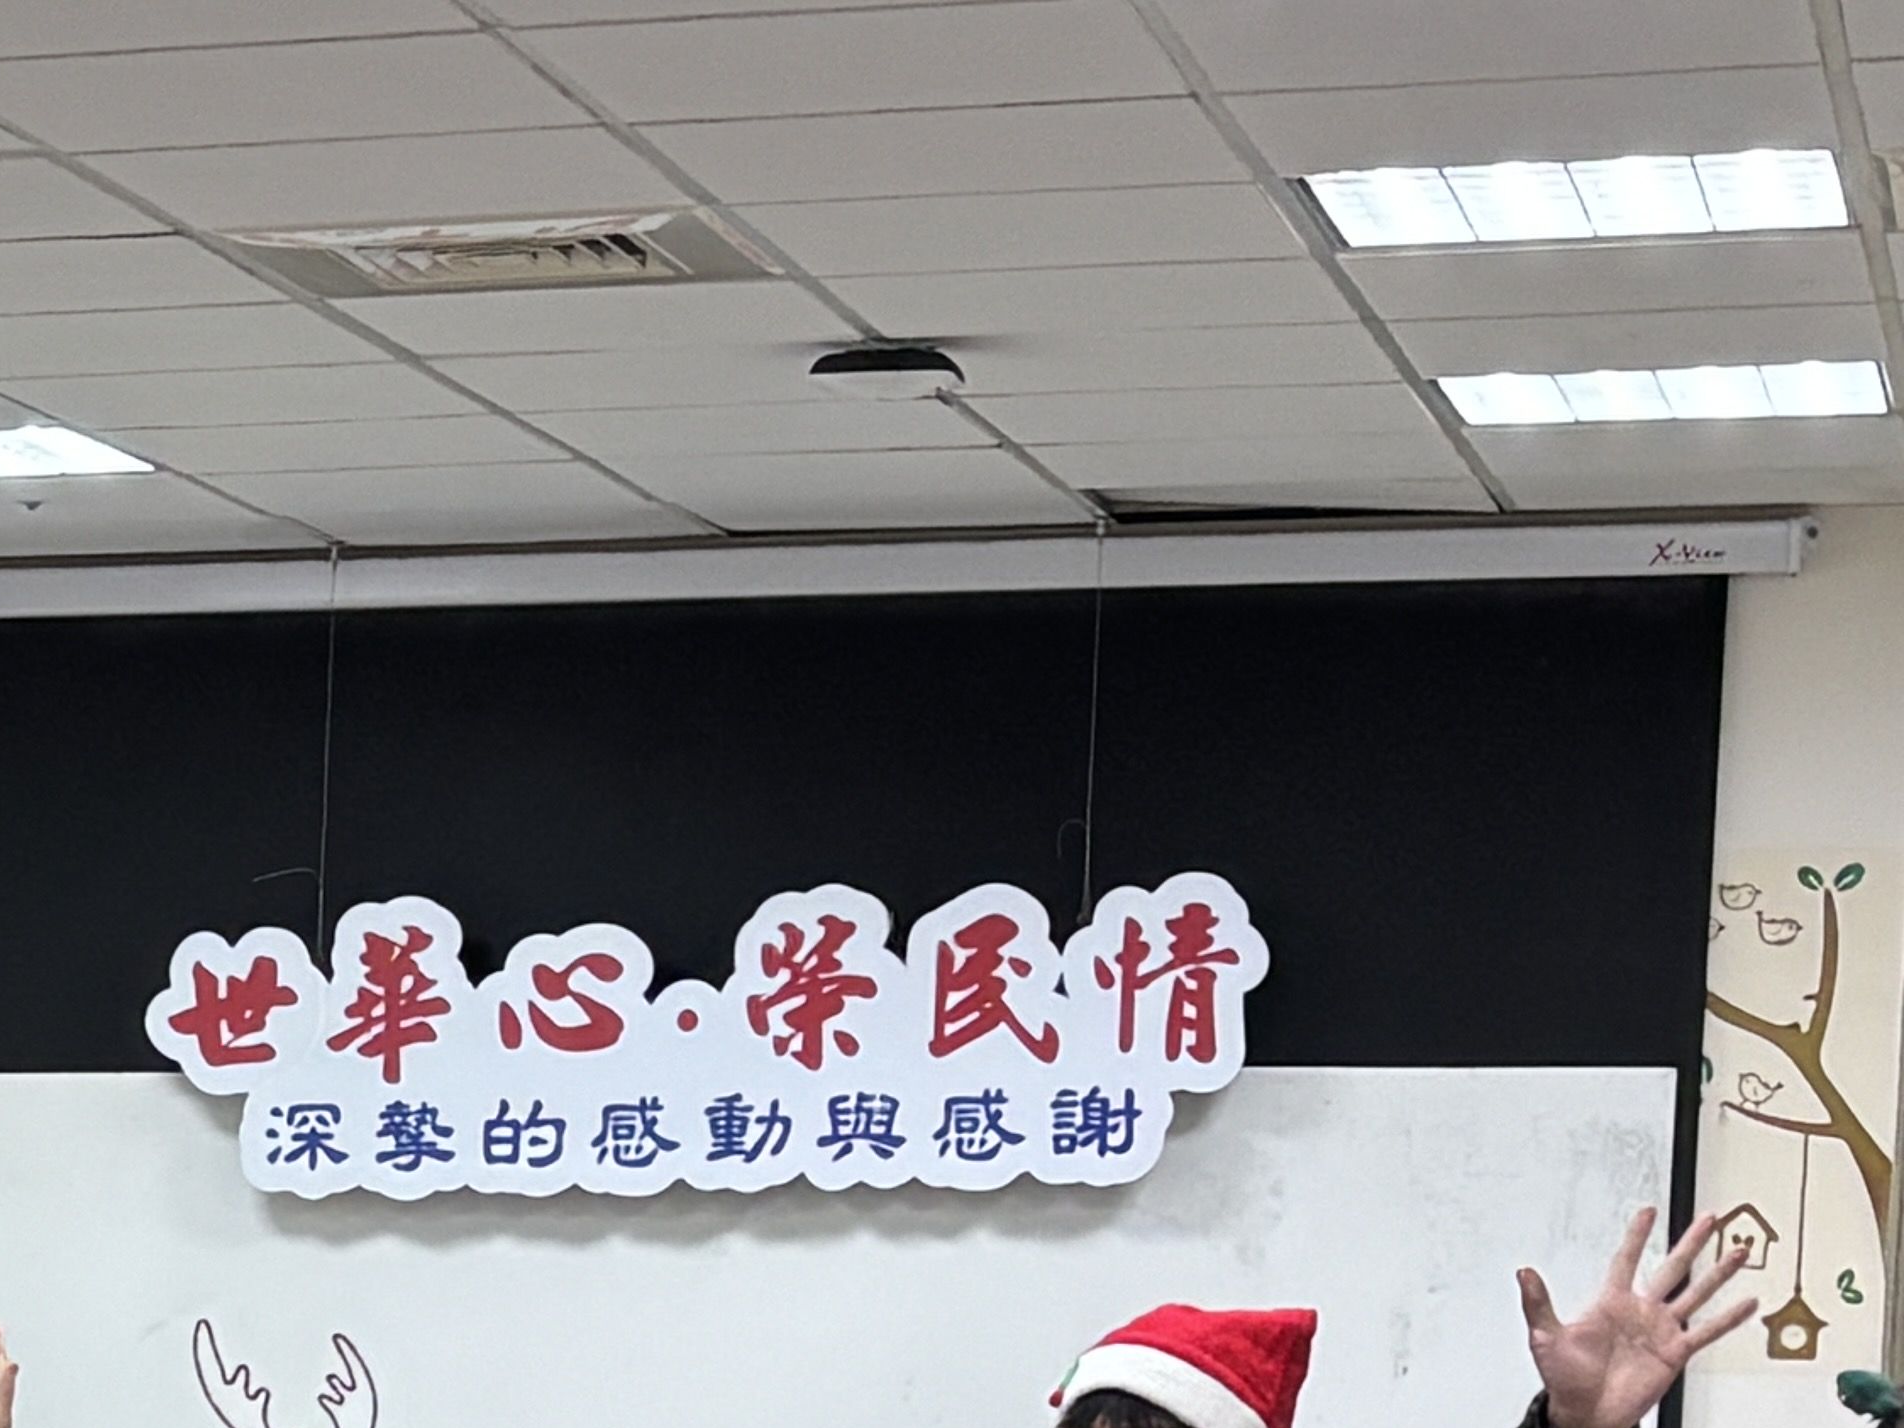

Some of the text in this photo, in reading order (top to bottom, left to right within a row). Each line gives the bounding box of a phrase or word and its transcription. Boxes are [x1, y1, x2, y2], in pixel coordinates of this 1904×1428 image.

[264, 1088, 1143, 1172] 深摯的感動與感謝
